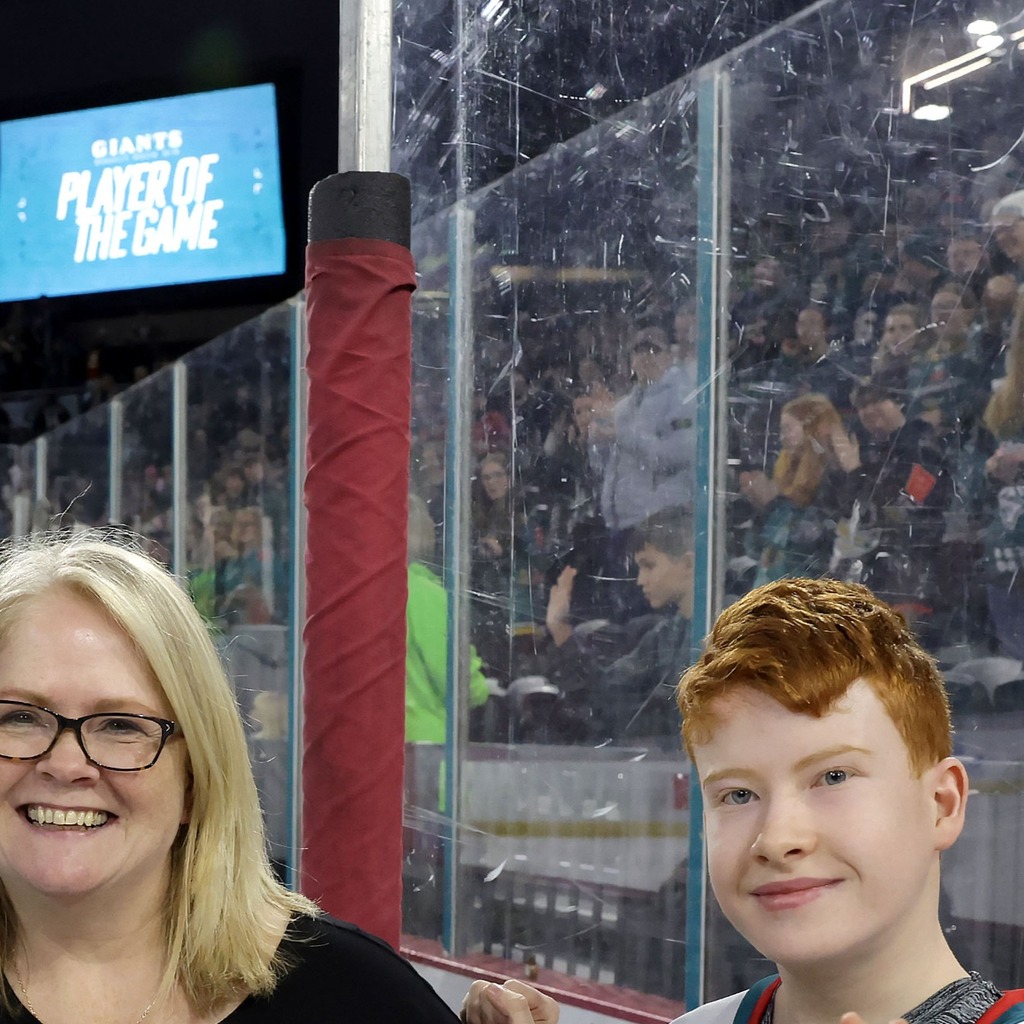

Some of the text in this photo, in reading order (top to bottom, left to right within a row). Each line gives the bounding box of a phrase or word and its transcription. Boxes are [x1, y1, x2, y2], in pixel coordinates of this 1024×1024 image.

[91, 129, 182, 158] GIANTS
[56, 153, 220, 221] PLAYER OF
[74, 199, 223, 263] THE GAME
